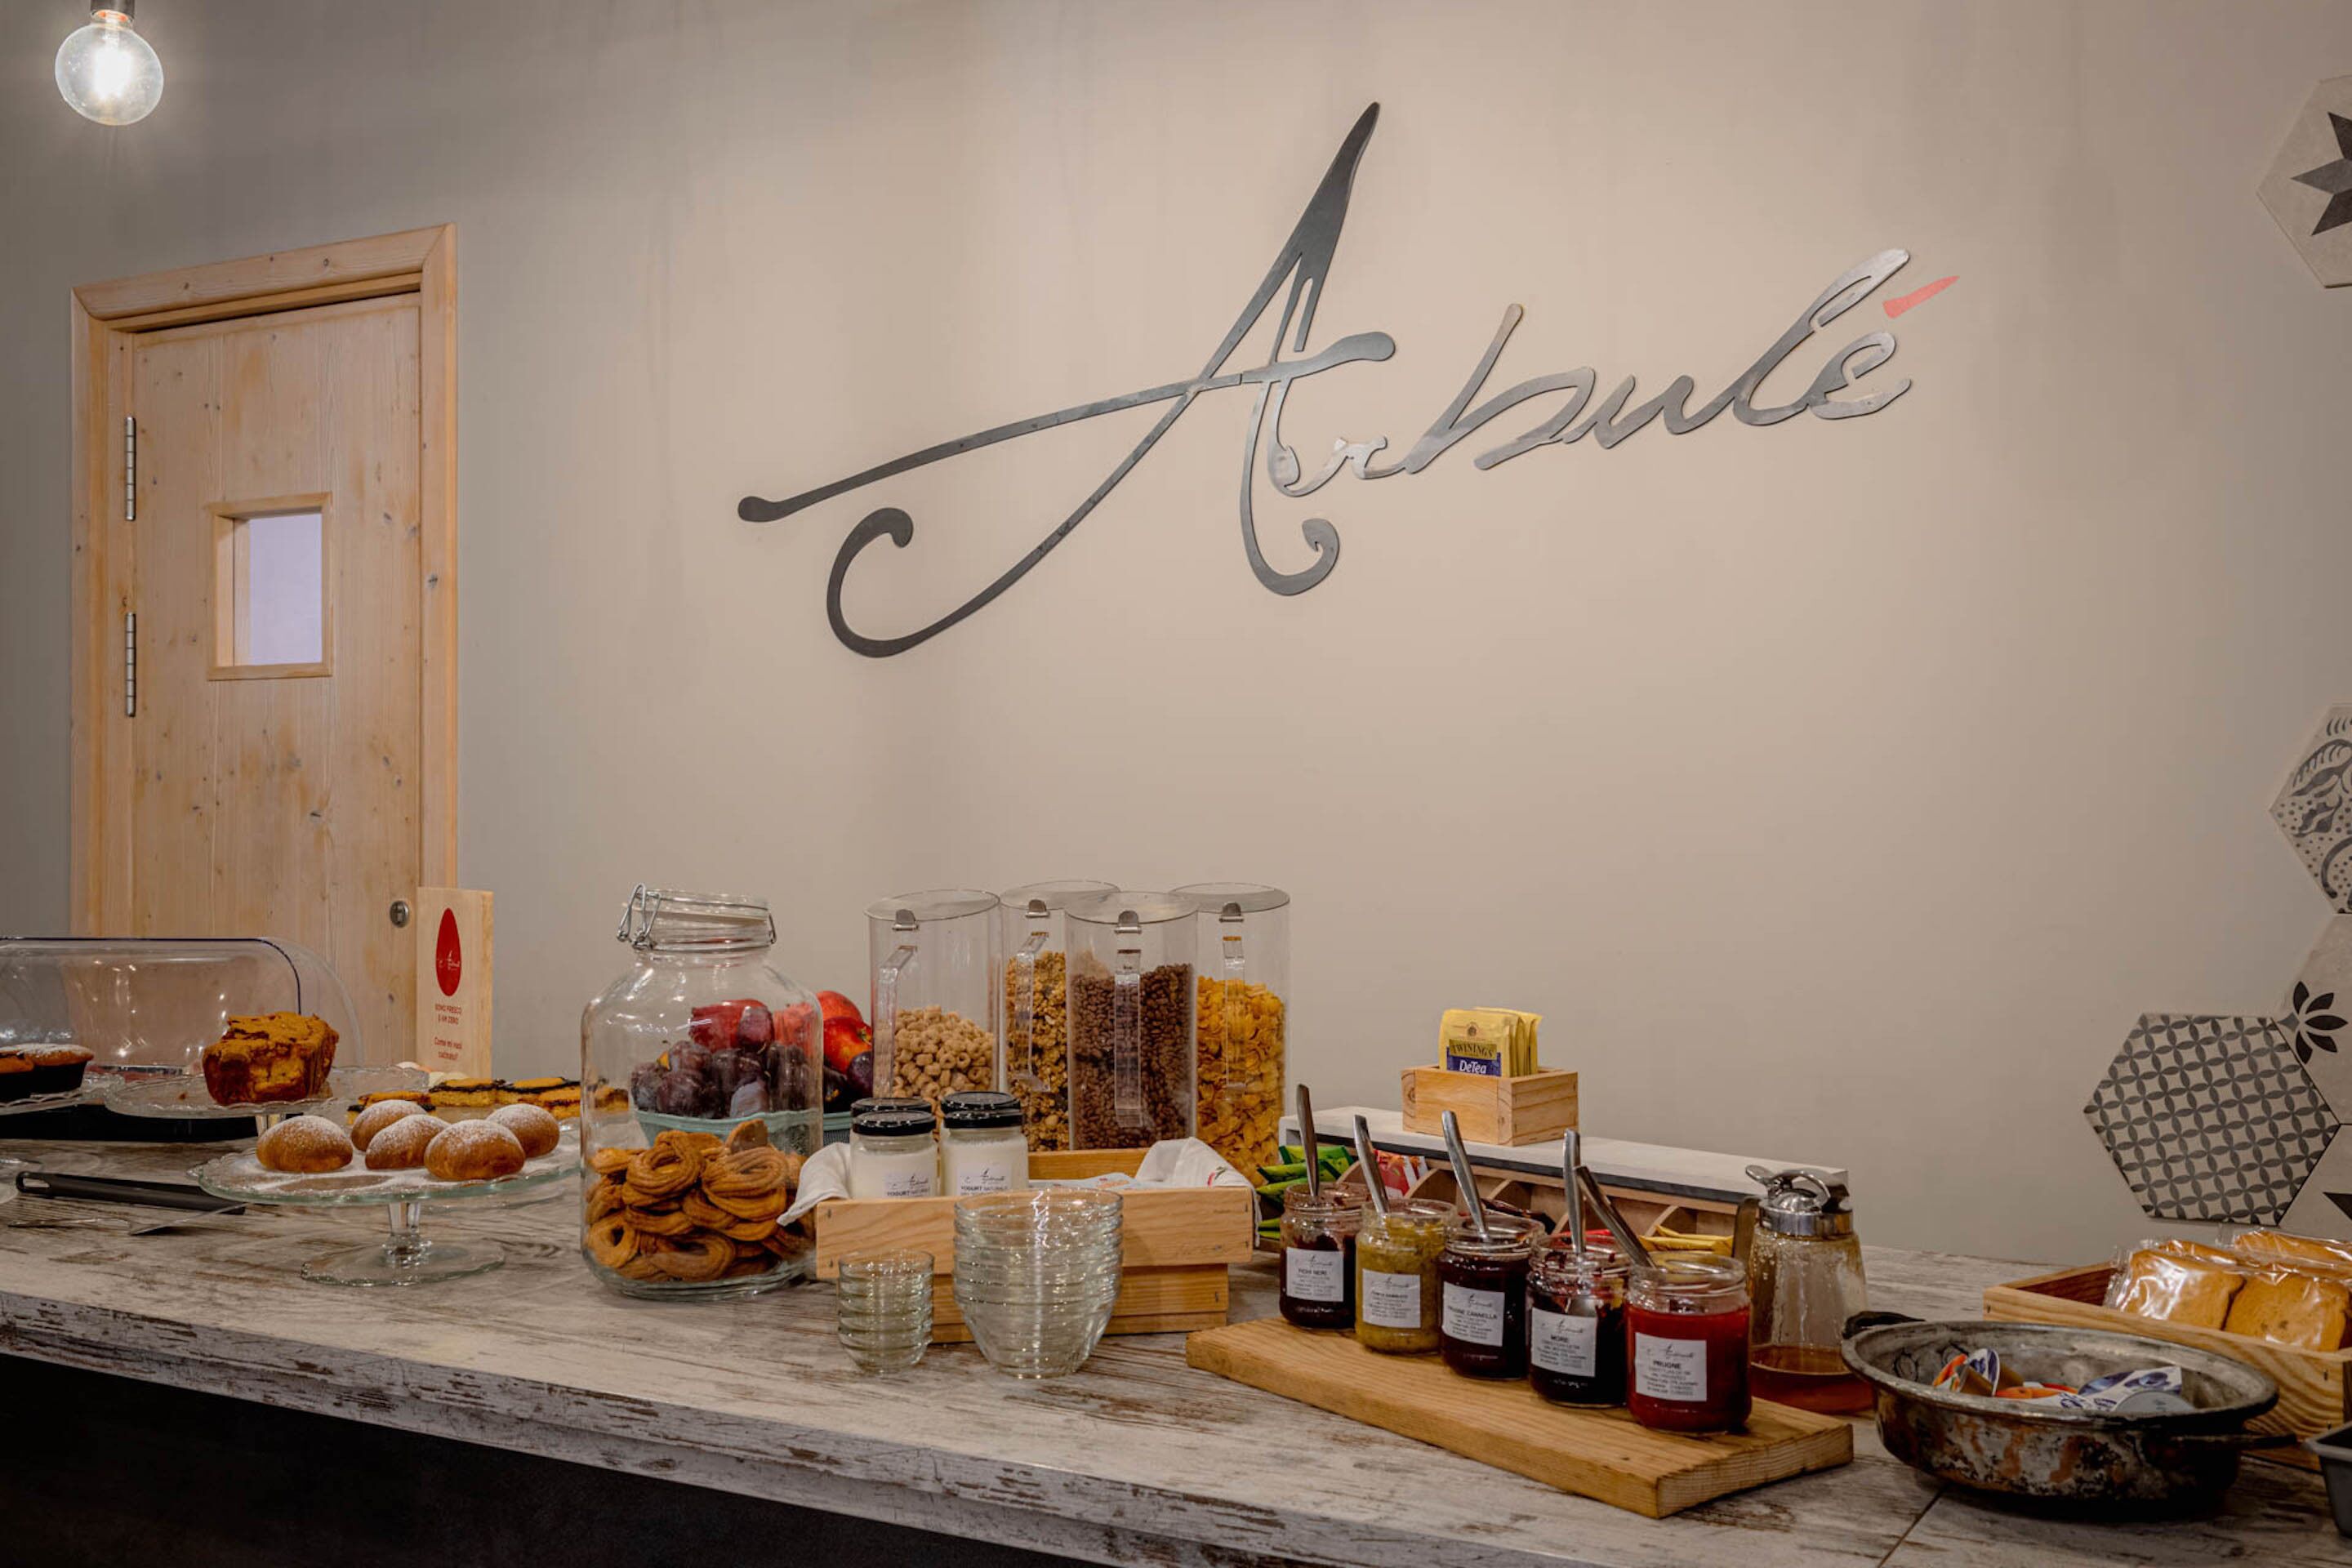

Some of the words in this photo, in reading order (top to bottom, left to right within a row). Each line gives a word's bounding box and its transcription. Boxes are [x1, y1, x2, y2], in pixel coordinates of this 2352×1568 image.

[737, 101, 1958, 657] Arbulé
[1459, 1060, 1488, 1074] DeTea
[1551, 1334, 1569, 1343] MORE
[1653, 1360, 1682, 1370] PRUGNE
